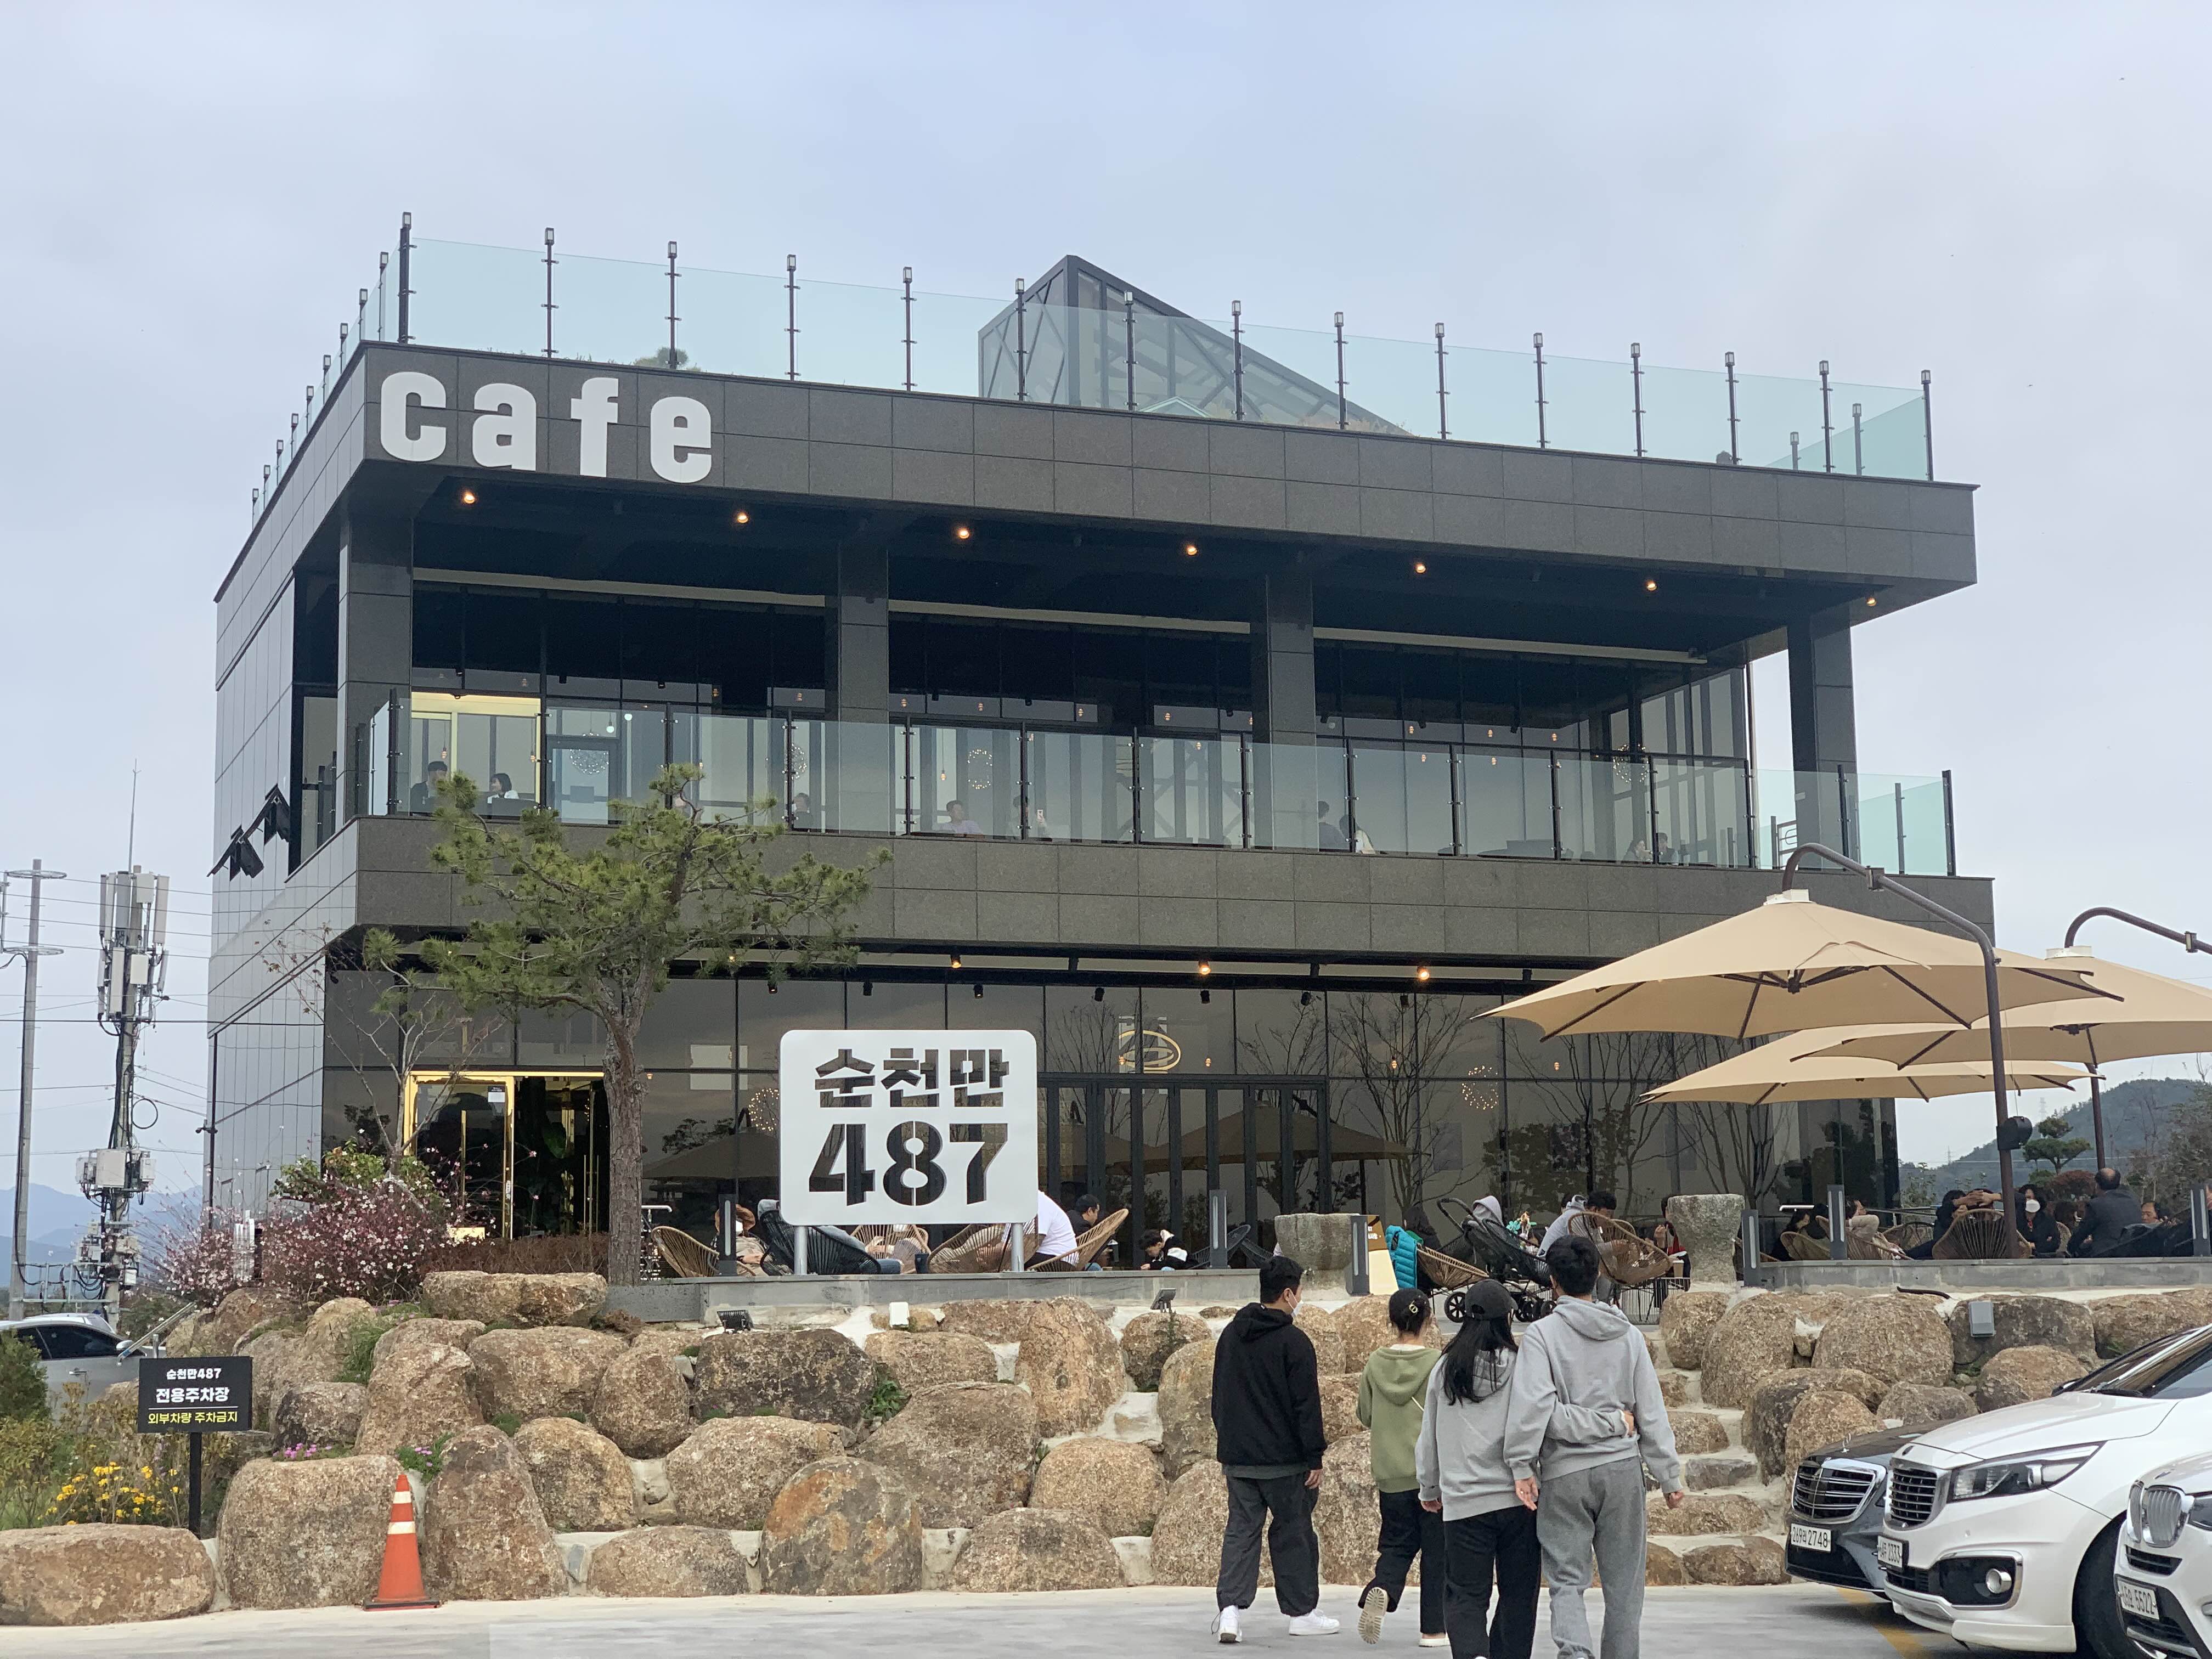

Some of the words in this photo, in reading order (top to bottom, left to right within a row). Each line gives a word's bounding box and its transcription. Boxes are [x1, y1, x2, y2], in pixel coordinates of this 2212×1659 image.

[380, 371, 712, 484] cafe
[814, 1048, 1010, 1108] 순천만
[809, 1120, 1009, 1206] 487
[166, 1368, 222, 1380] 순천만487
[156, 1387, 230, 1403] 전용주차장
[148, 1412, 192, 1425] 외부차량
[194, 1411, 238, 1424] 주차금지
[1808, 1530, 1828, 1548] 2748
[2134, 1589, 2155, 1615] 5522
